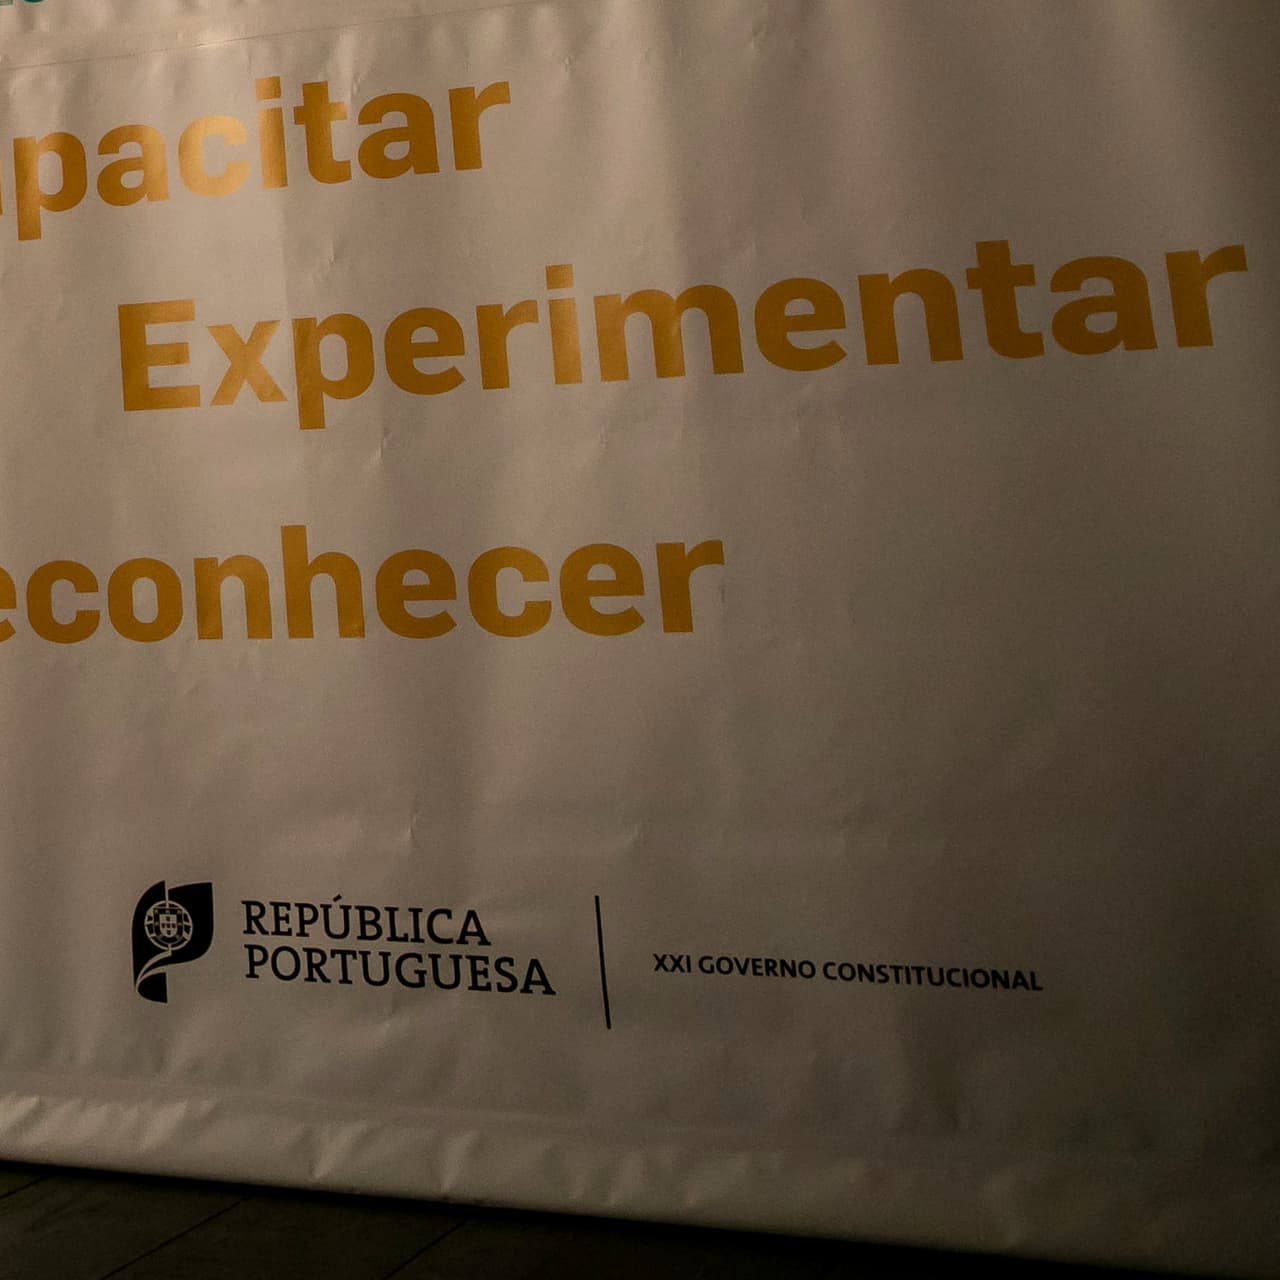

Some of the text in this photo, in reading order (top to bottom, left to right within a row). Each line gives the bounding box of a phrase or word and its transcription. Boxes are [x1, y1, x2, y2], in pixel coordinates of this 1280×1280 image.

[117, 239, 1249, 431] Experimentar
[242, 894, 492, 949] REPÚBLICA
[243, 943, 557, 999] PORTUGUESA
[652, 951, 1045, 995] XXI GOVERNO CONSTITUCIONAL
